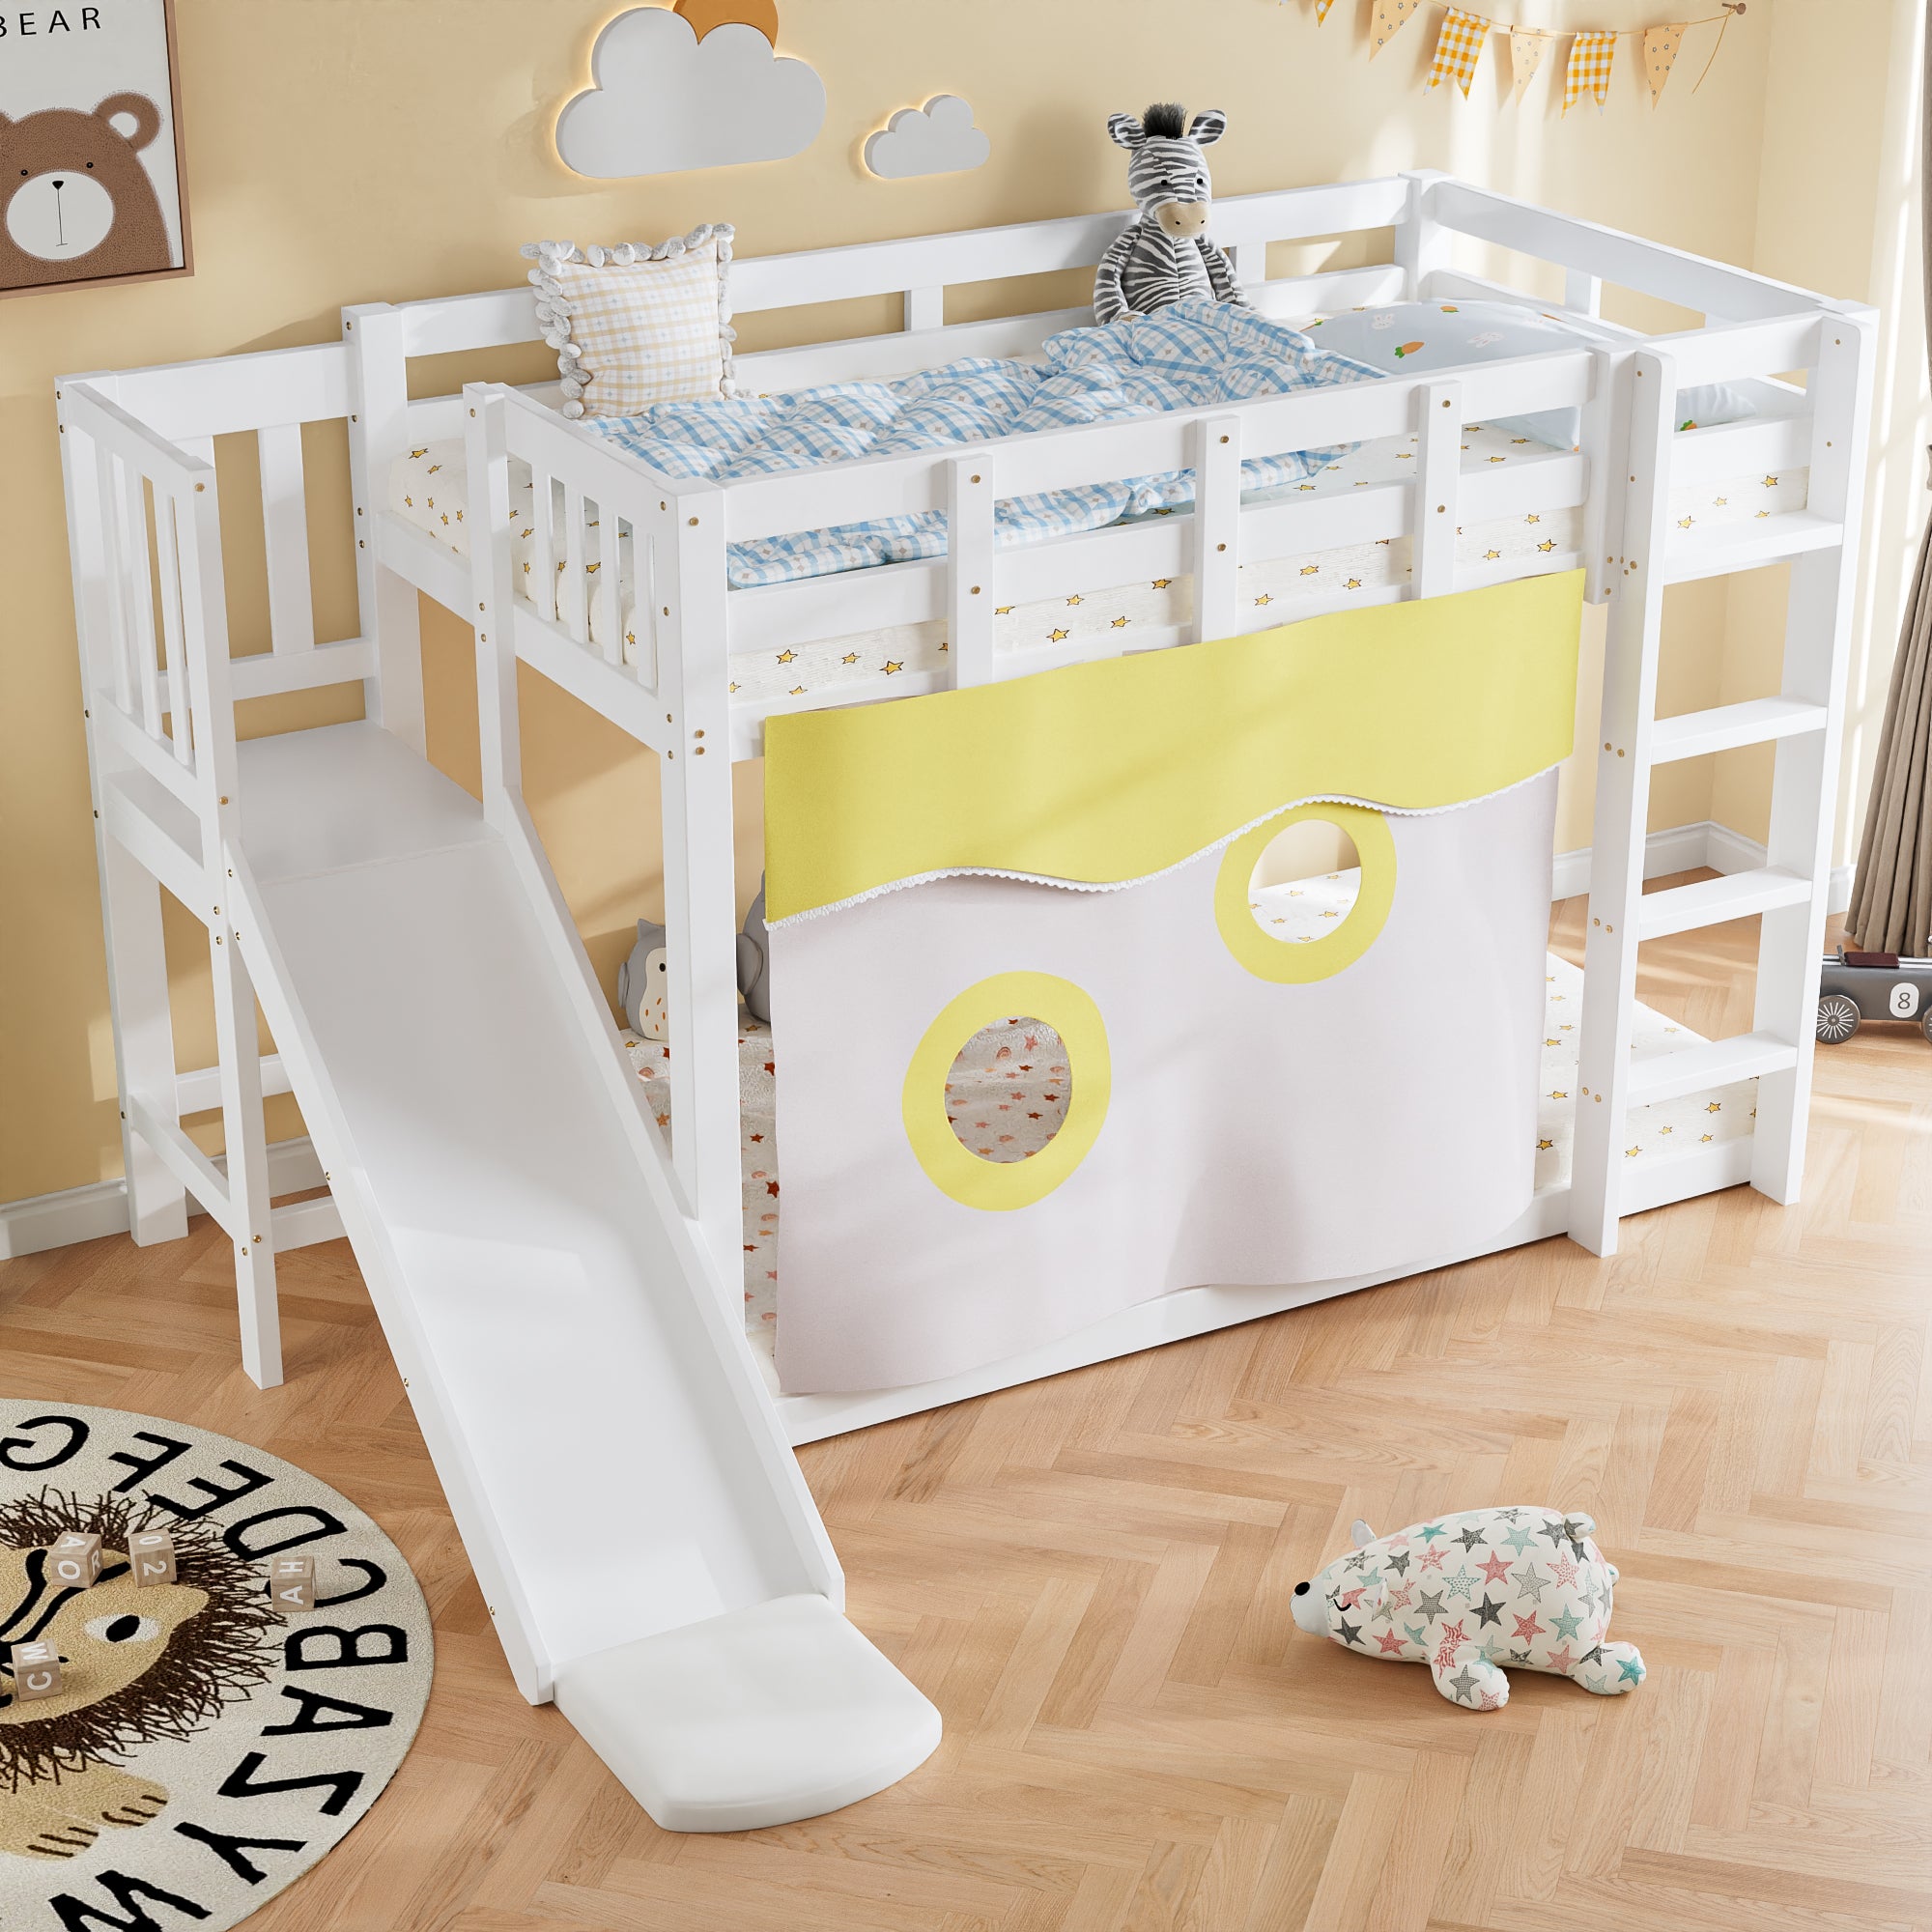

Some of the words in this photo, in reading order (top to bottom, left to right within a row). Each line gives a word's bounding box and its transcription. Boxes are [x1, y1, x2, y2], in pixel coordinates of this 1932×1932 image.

[1897, 992, 1911, 1009] 8
[143, 1560, 167, 1577] 2
[279, 1585, 304, 1605] A
[26, 1671, 52, 1690] C
